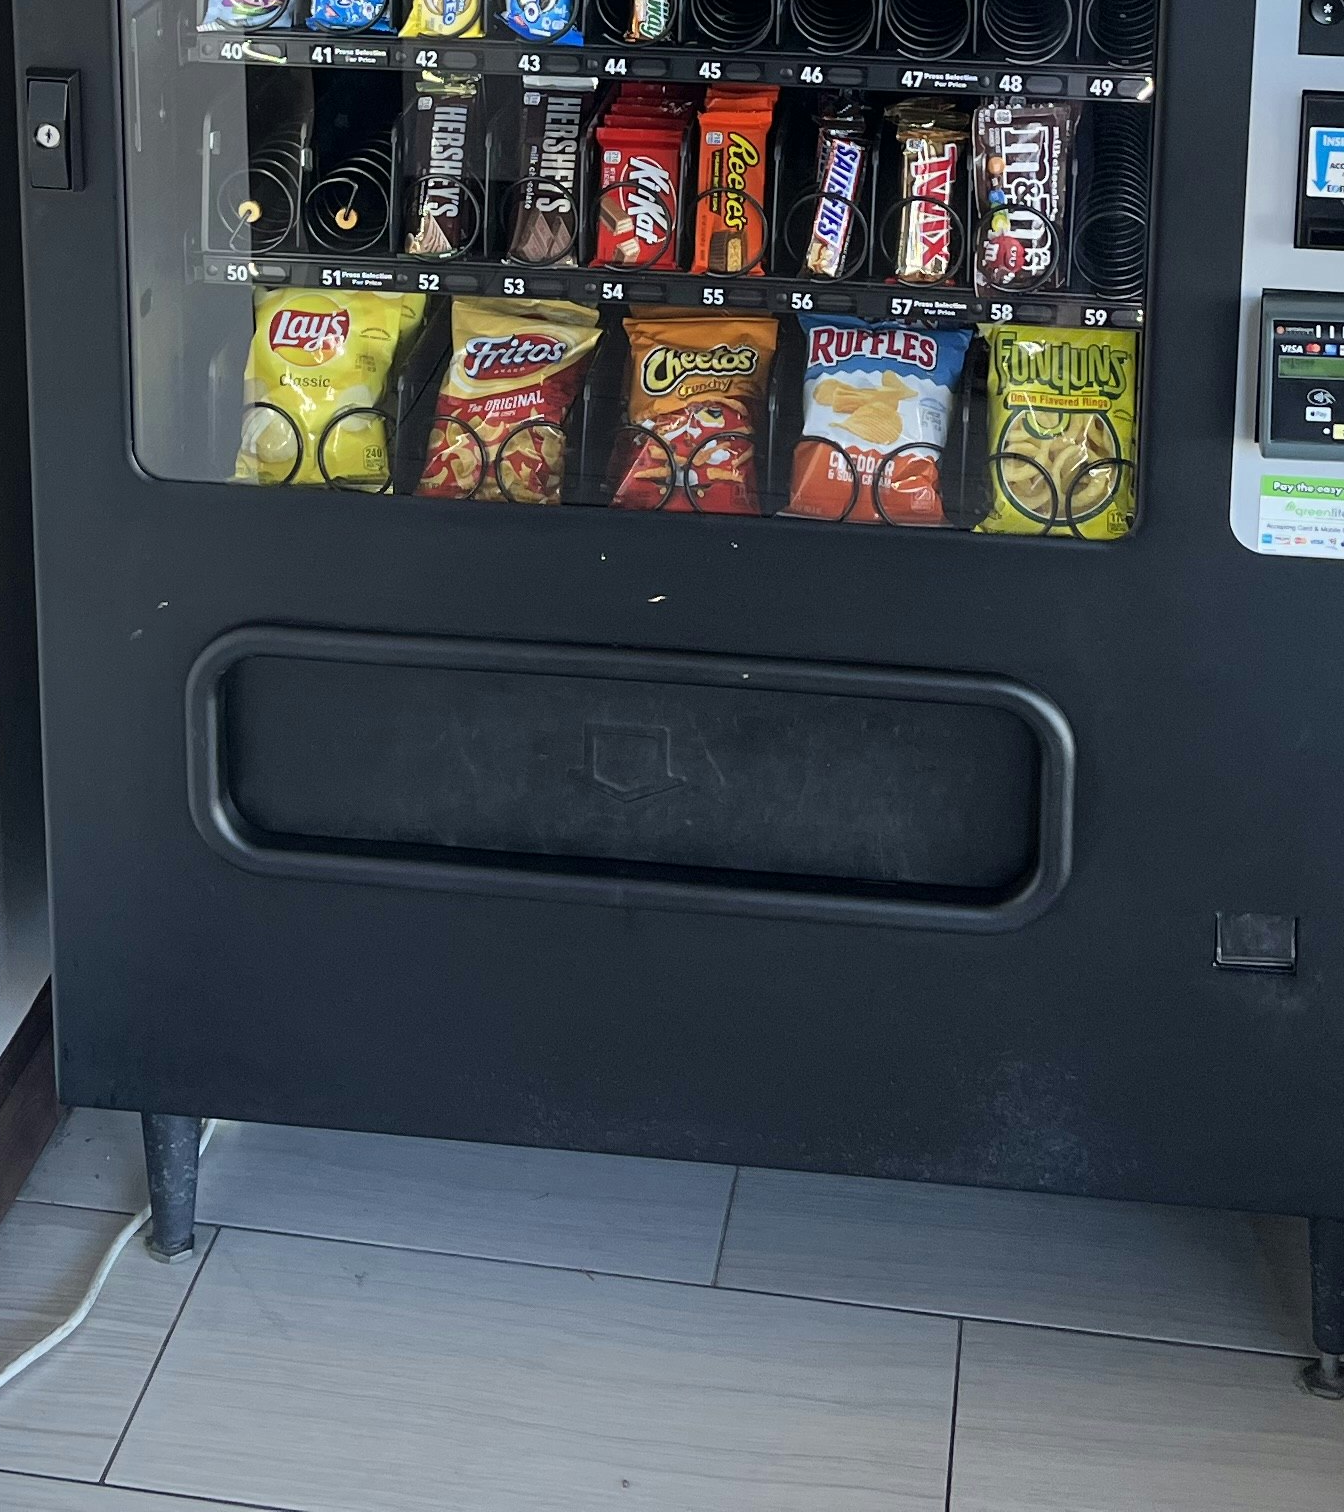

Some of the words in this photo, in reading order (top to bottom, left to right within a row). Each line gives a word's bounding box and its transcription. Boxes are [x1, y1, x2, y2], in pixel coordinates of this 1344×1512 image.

[221, 43, 242, 59] 40
[312, 47, 332, 64] 41
[416, 50, 438, 67] 42
[519, 55, 540, 72] 43
[605, 59, 627, 75] 44
[699, 62, 721, 79] 45
[801, 67, 823, 83] 46
[901, 71, 923, 88] 47
[999, 75, 1022, 92] 48
[1089, 79, 1113, 96] 49
[428, 106, 468, 218] HERSHEY'S
[536, 97, 582, 213] HERSHEY'S
[525, 166, 536, 210] chcolate
[724, 132, 759, 230] Reese's
[914, 146, 956, 266] TWIX
[227, 265, 248, 281] 50
[322, 269, 341, 286] 51
[418, 274, 439, 290] 52
[504, 278, 524, 294] 53
[602, 284, 623, 299] 54
[703, 289, 724, 305] 55
[791, 293, 813, 310] 56
[891, 299, 913, 315] 57
[990, 304, 1013, 320] 58
[1084, 309, 1107, 325] 59
[273, 311, 347, 352] Lay's
[810, 329, 936, 367] RUFFLES
[1280, 344, 1303, 353] VISA
[465, 337, 567, 377] Fritos
[646, 347, 753, 390] Cheetos
[279, 373, 331, 388] Classic
[678, 377, 732, 398] Crunchy
[484, 390, 545, 412] ORIGINAL
[1040, 395, 1079, 407] Flavored
[1082, 397, 1108, 408] Rings
[365, 448, 382, 458] 240
[837, 471, 856, 482] SOU
[862, 474, 891, 488] CRAM
[1273, 481, 1294, 493] Pay
[1296, 482, 1315, 492] the
[1317, 487, 1342, 497] easy
